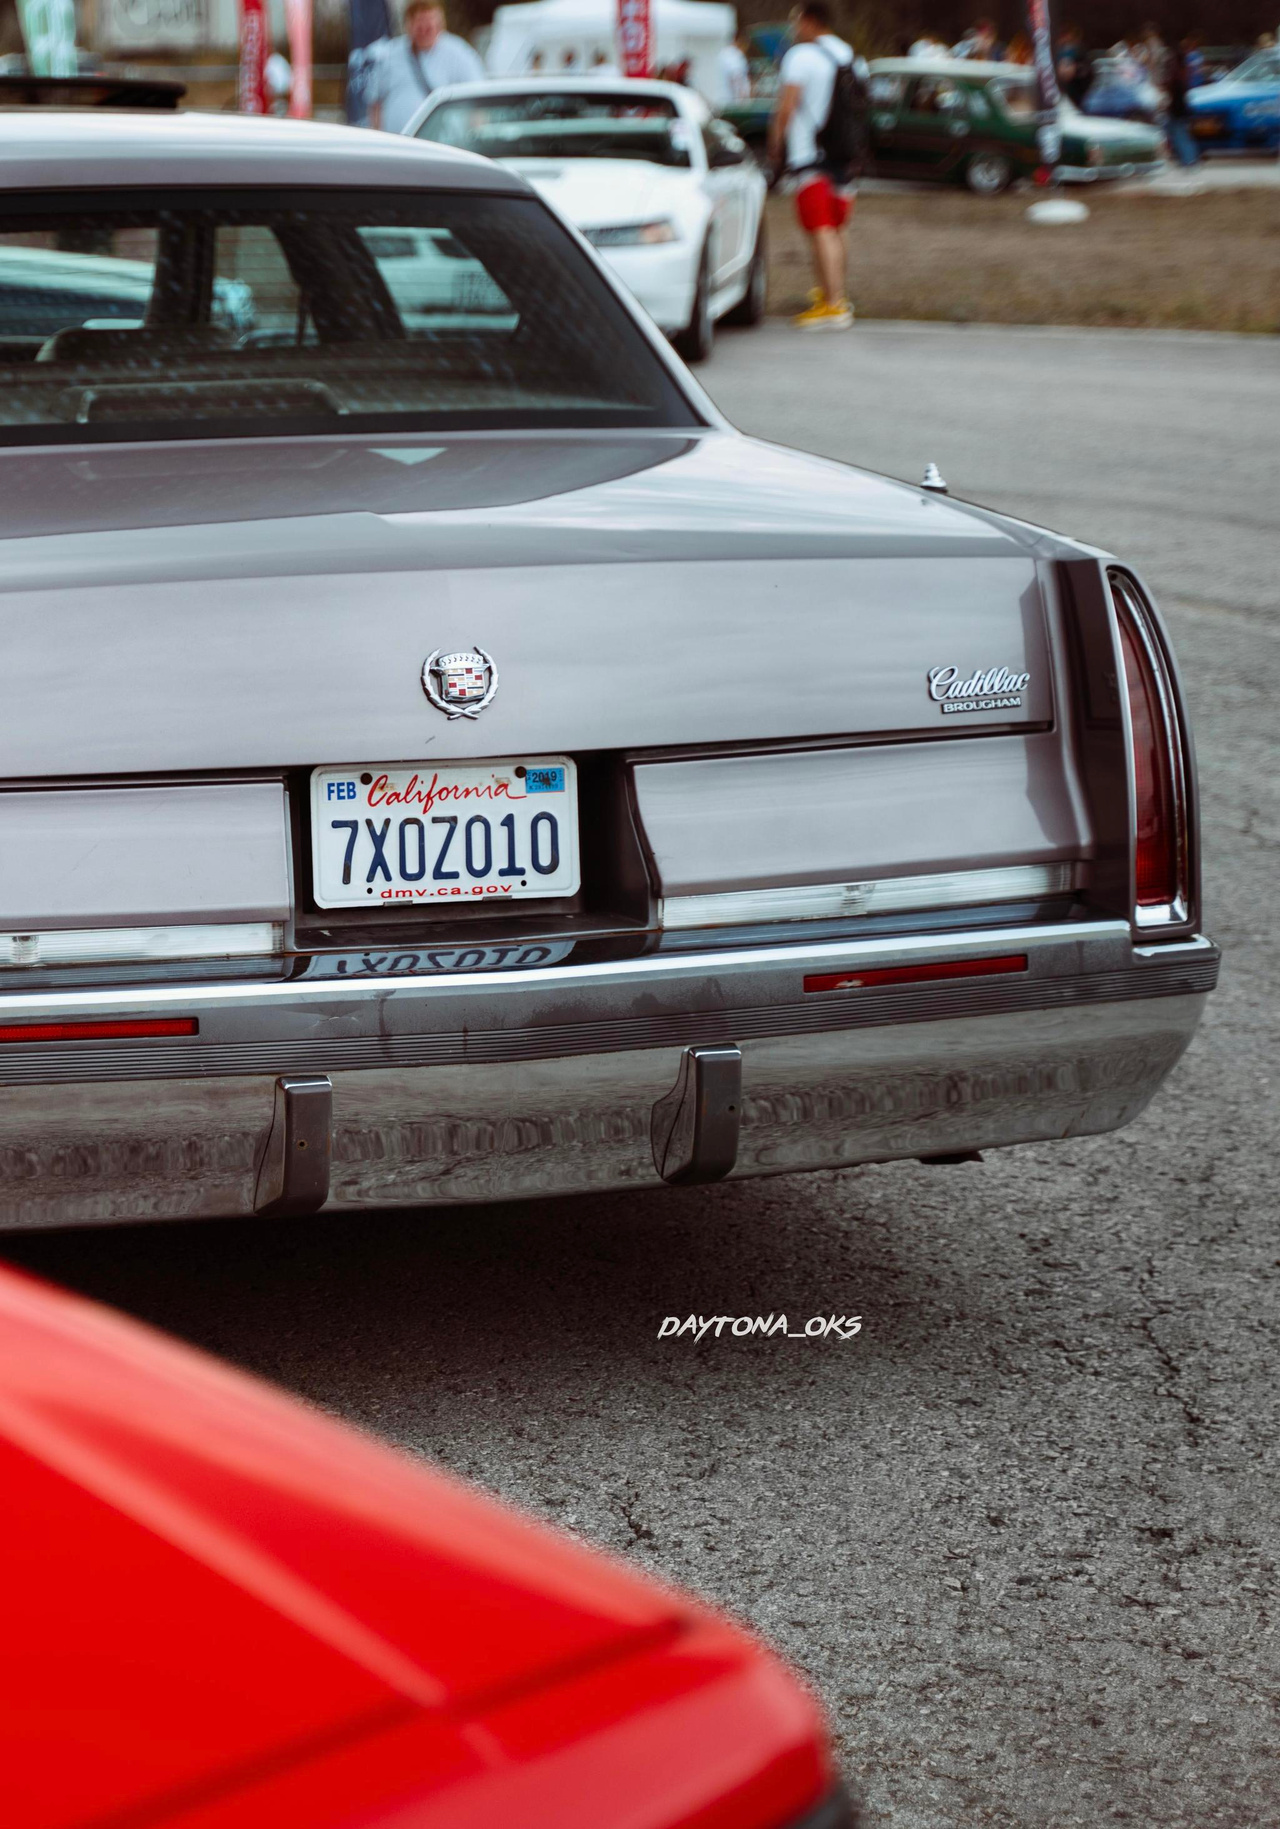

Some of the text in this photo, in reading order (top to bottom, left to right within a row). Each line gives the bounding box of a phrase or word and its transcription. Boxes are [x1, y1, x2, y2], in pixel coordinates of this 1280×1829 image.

[928, 666, 1030, 700] Cadillac
[942, 697, 1021, 713] BROUGHAM
[531, 770, 558, 783] 2019
[327, 781, 357, 801] FEB
[367, 773, 527, 814] California
[331, 811, 560, 885] 7XOZ010
[380, 883, 513, 898] dmv.ca.gov
